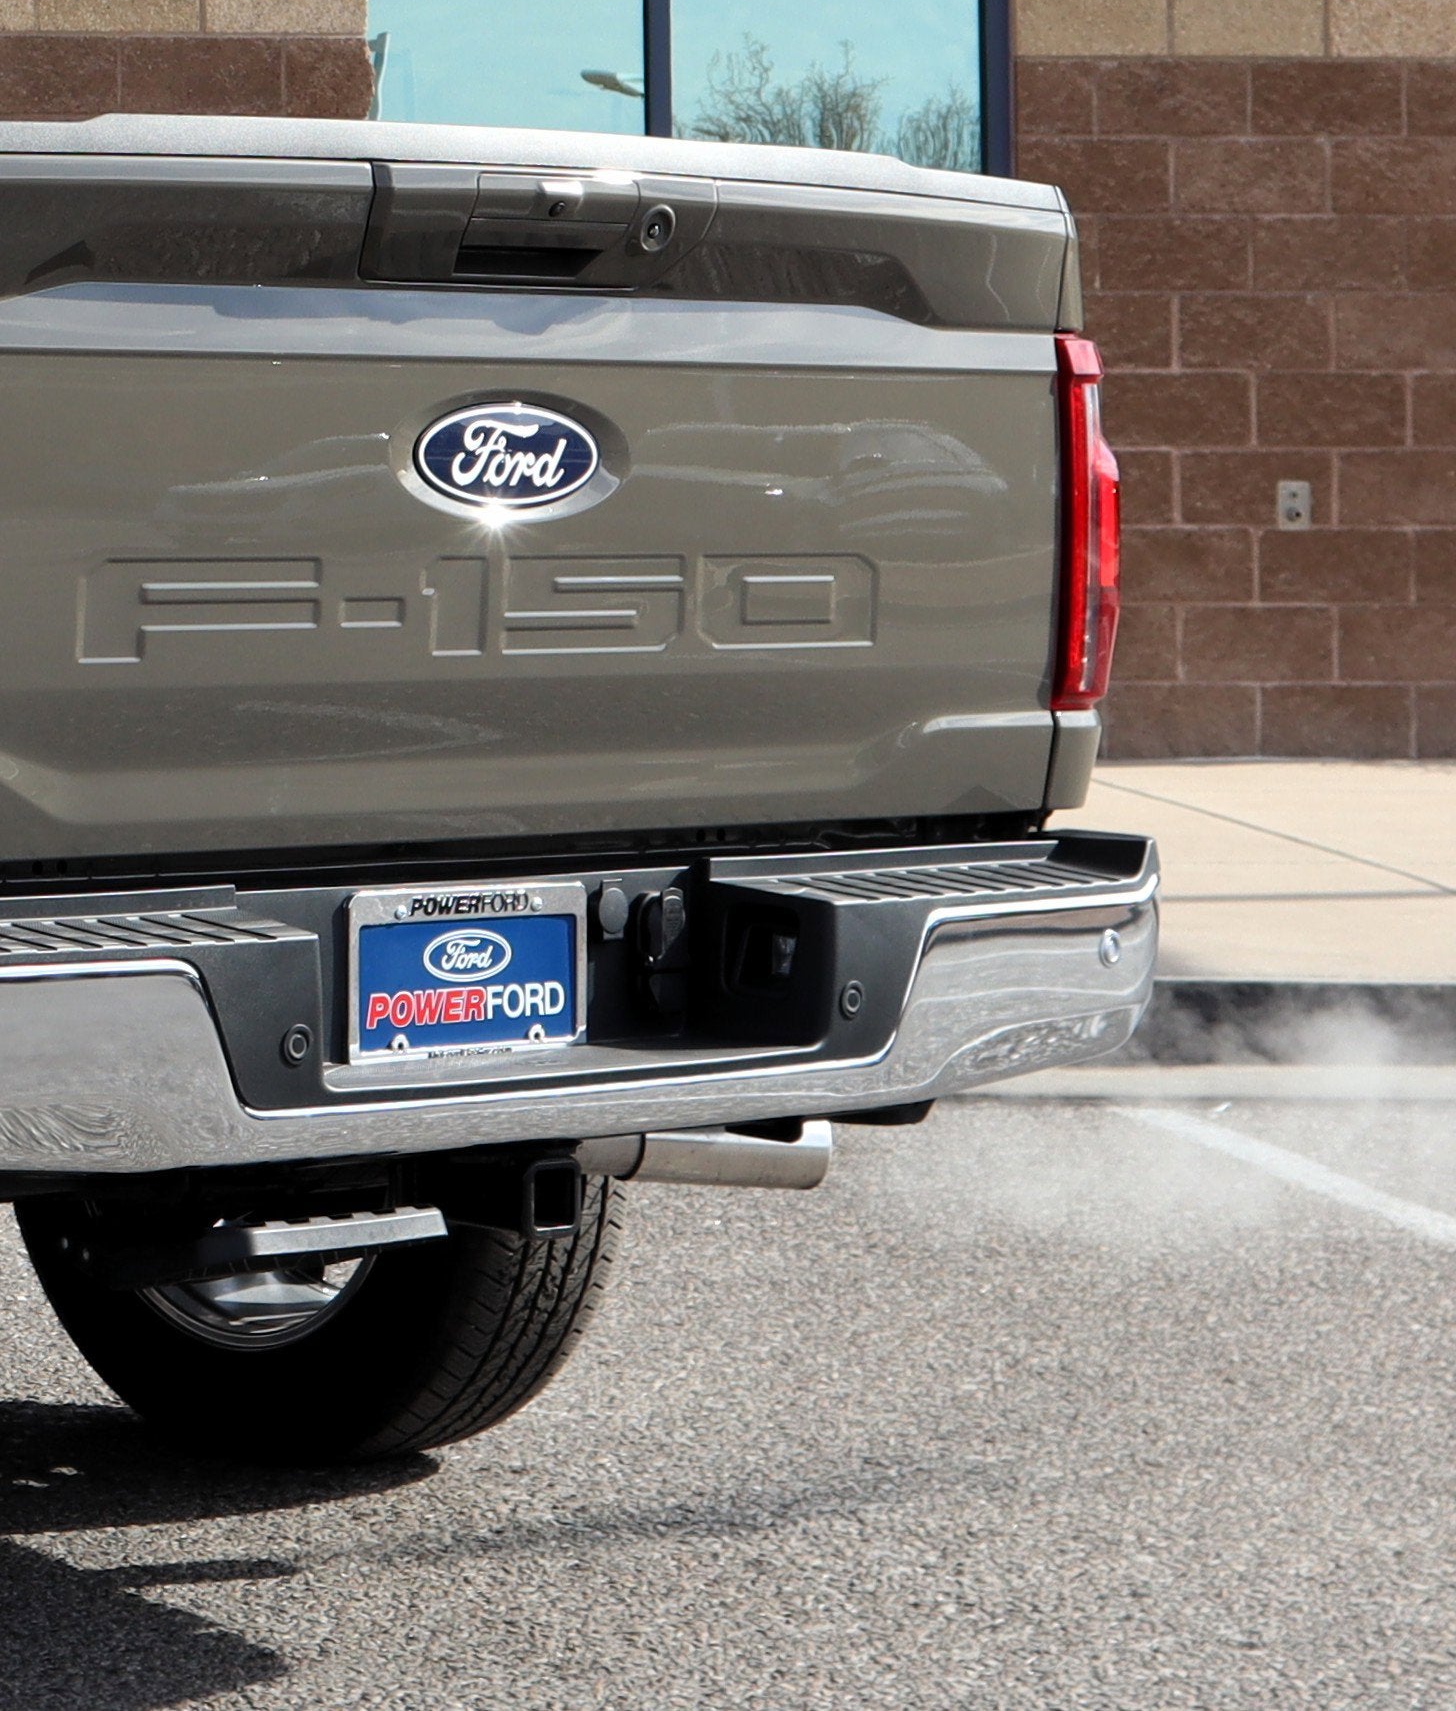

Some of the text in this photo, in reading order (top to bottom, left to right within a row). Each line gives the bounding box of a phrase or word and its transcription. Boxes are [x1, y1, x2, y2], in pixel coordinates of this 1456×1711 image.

[451, 419, 568, 487] Ford
[75, 552, 880, 664] F-150
[409, 890, 528, 917] POWERFORD
[441, 939, 493, 970] Ford
[366, 982, 565, 1030] POWERFORD
